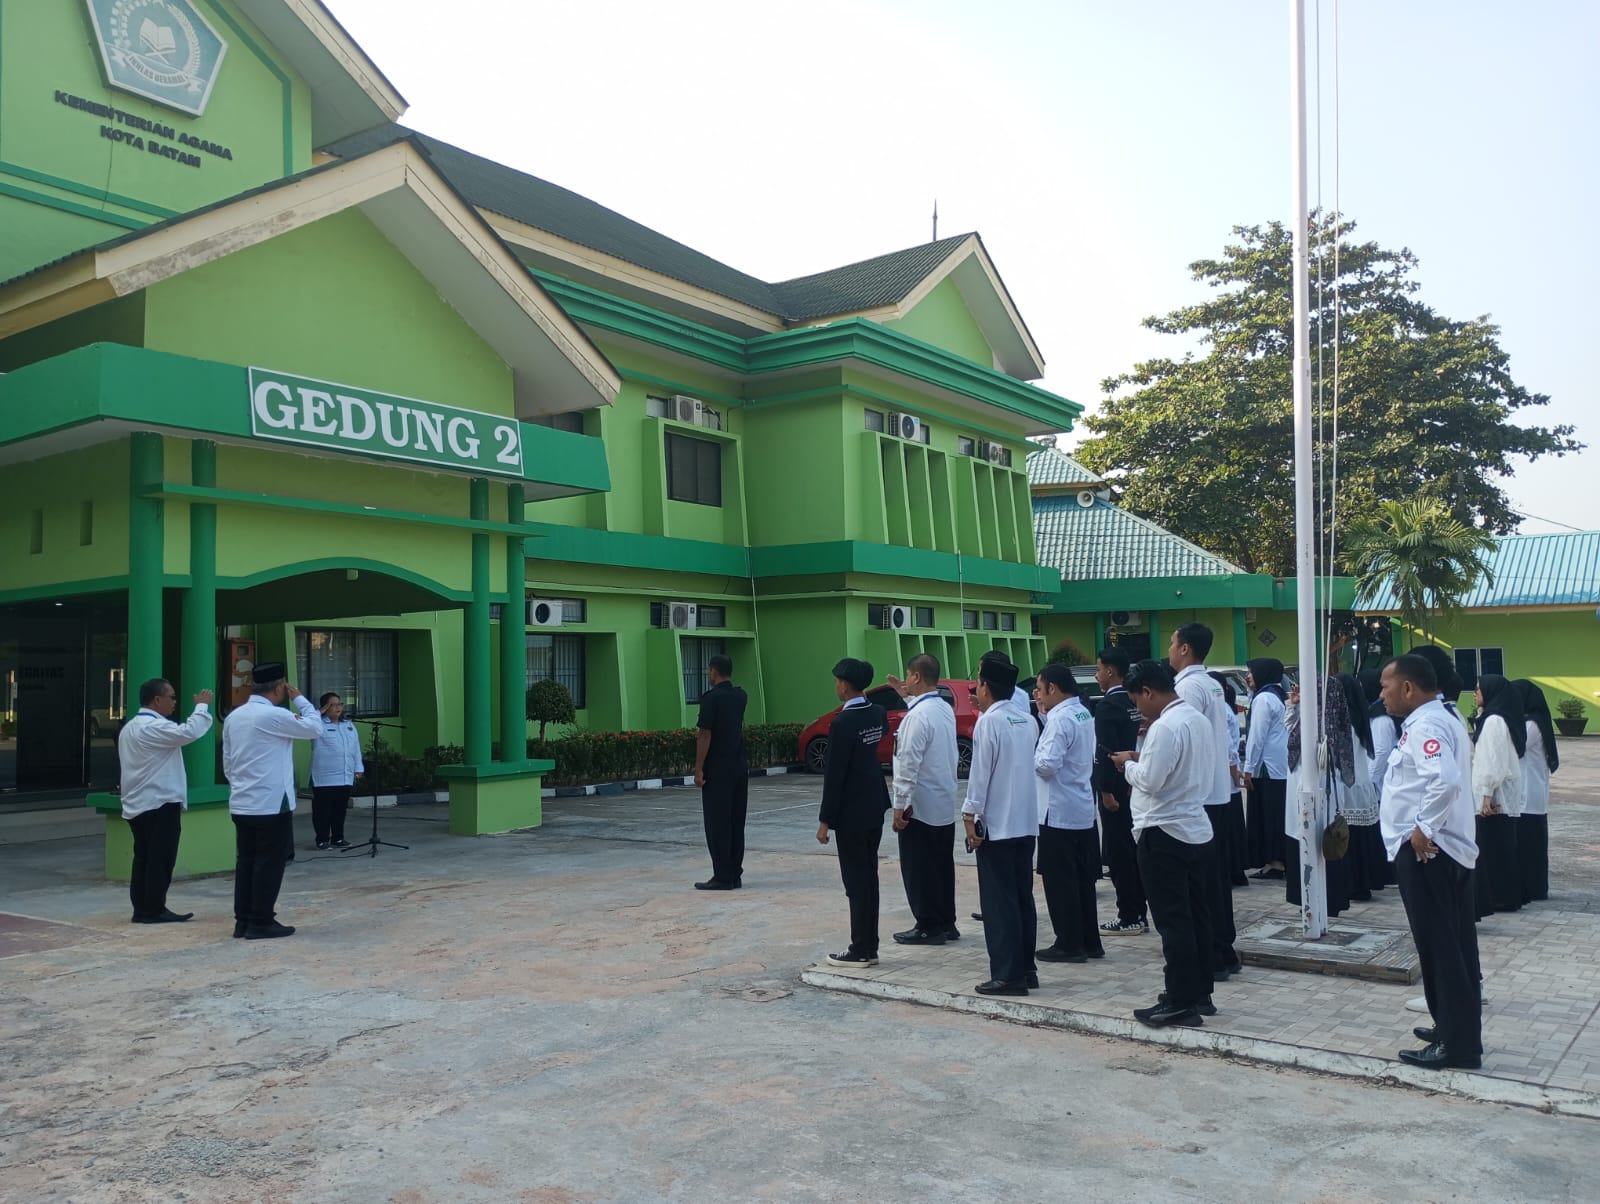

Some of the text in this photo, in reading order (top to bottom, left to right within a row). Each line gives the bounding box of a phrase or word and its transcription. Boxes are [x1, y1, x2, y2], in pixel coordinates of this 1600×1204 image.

[54, 90, 233, 161] KEMENTERIAN AGAMA
[100, 125, 201, 169] KOTA BATAM
[254, 380, 520, 466] GEDUNG 2
